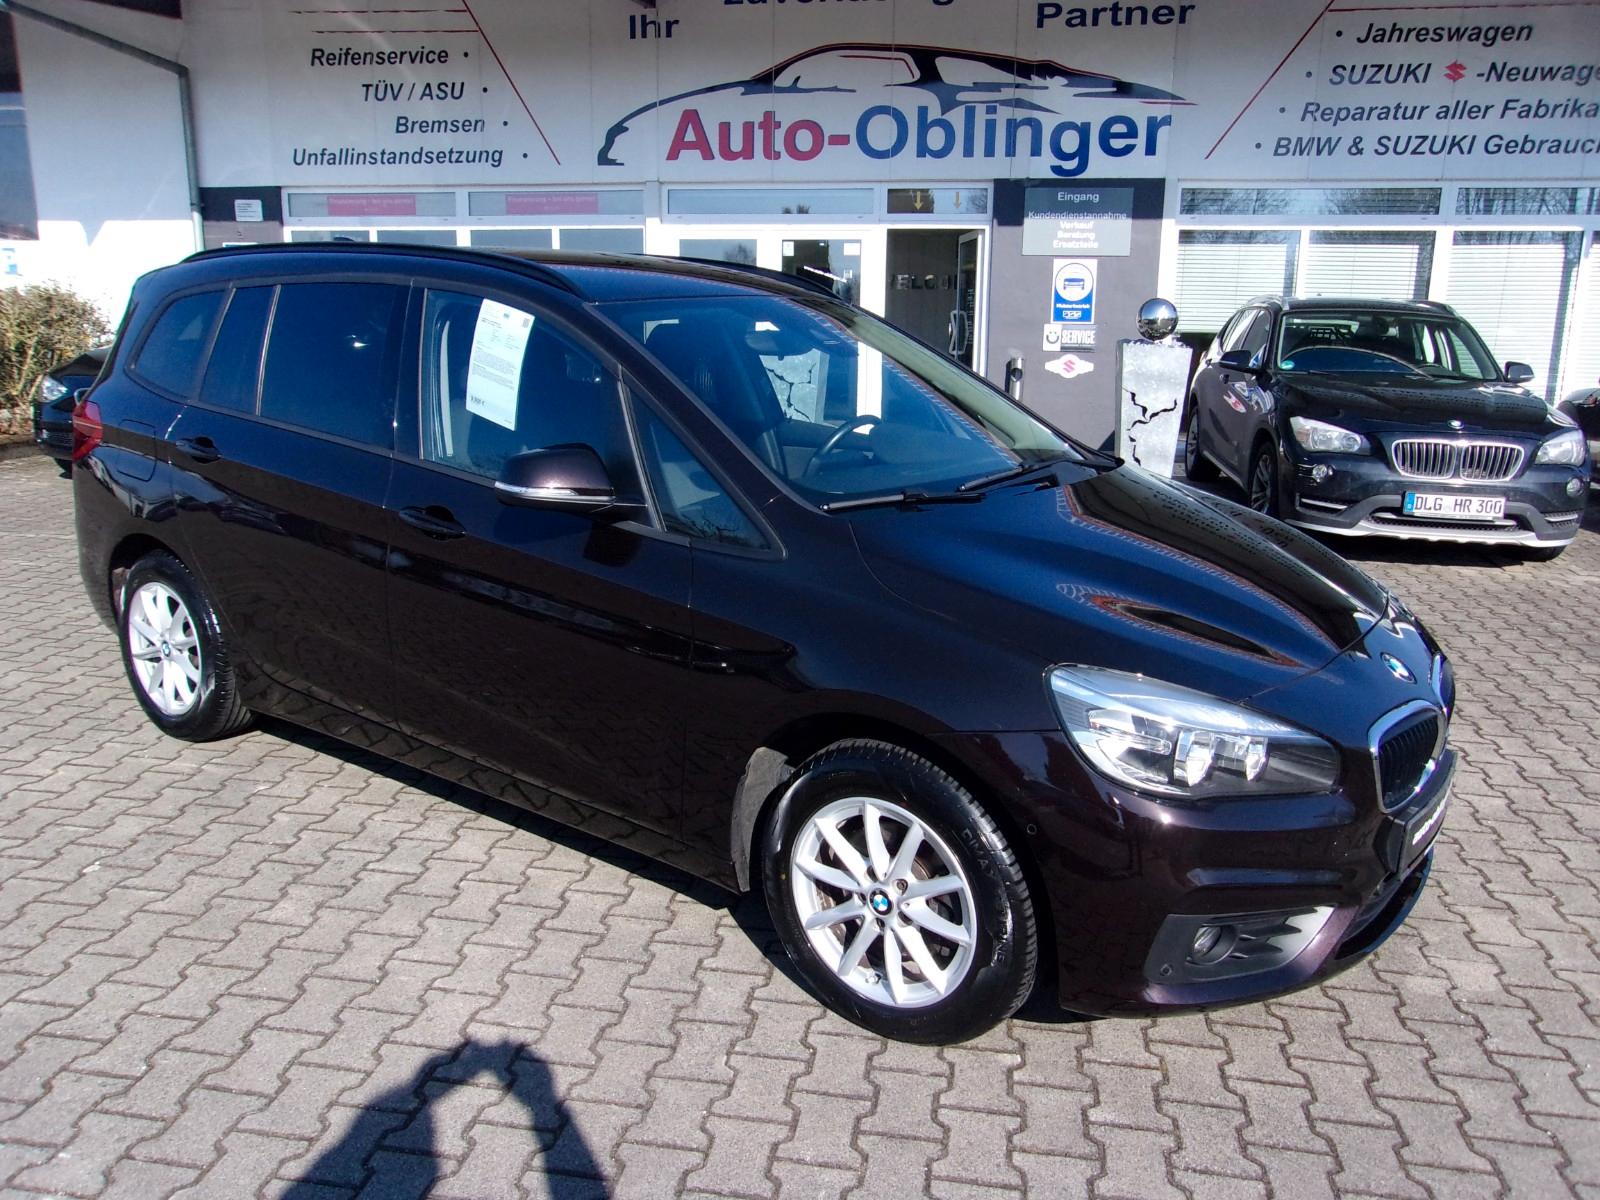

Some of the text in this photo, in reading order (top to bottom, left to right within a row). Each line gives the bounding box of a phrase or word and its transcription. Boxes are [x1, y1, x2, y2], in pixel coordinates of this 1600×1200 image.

[630, 15, 680, 39] Ihr
[1037, 4, 1195, 29] Partner
[1356, 23, 1533, 47] Jahreswagen
[310, 46, 449, 68] Reifenservice
[1329, 62, 1432, 85] SUZUKI
[361, 79, 404, 102] TÜV
[419, 81, 465, 101] ASU
[395, 115, 485, 134] Bremsen
[1300, 101, 1429, 127] Reparatur
[1435, 99, 1493, 120] aller
[293, 146, 503, 168] Unfallinstandsetzung
[1273, 136, 1342, 157] BMW
[1347, 135, 1365, 157] &
[1374, 134, 1475, 157] SUZUKI
[1057, 191, 1100, 203] Eingang
[1028, 210, 1127, 221] Kundendienstannahme
[1414, 496, 1503, 514] DLG HR 300
